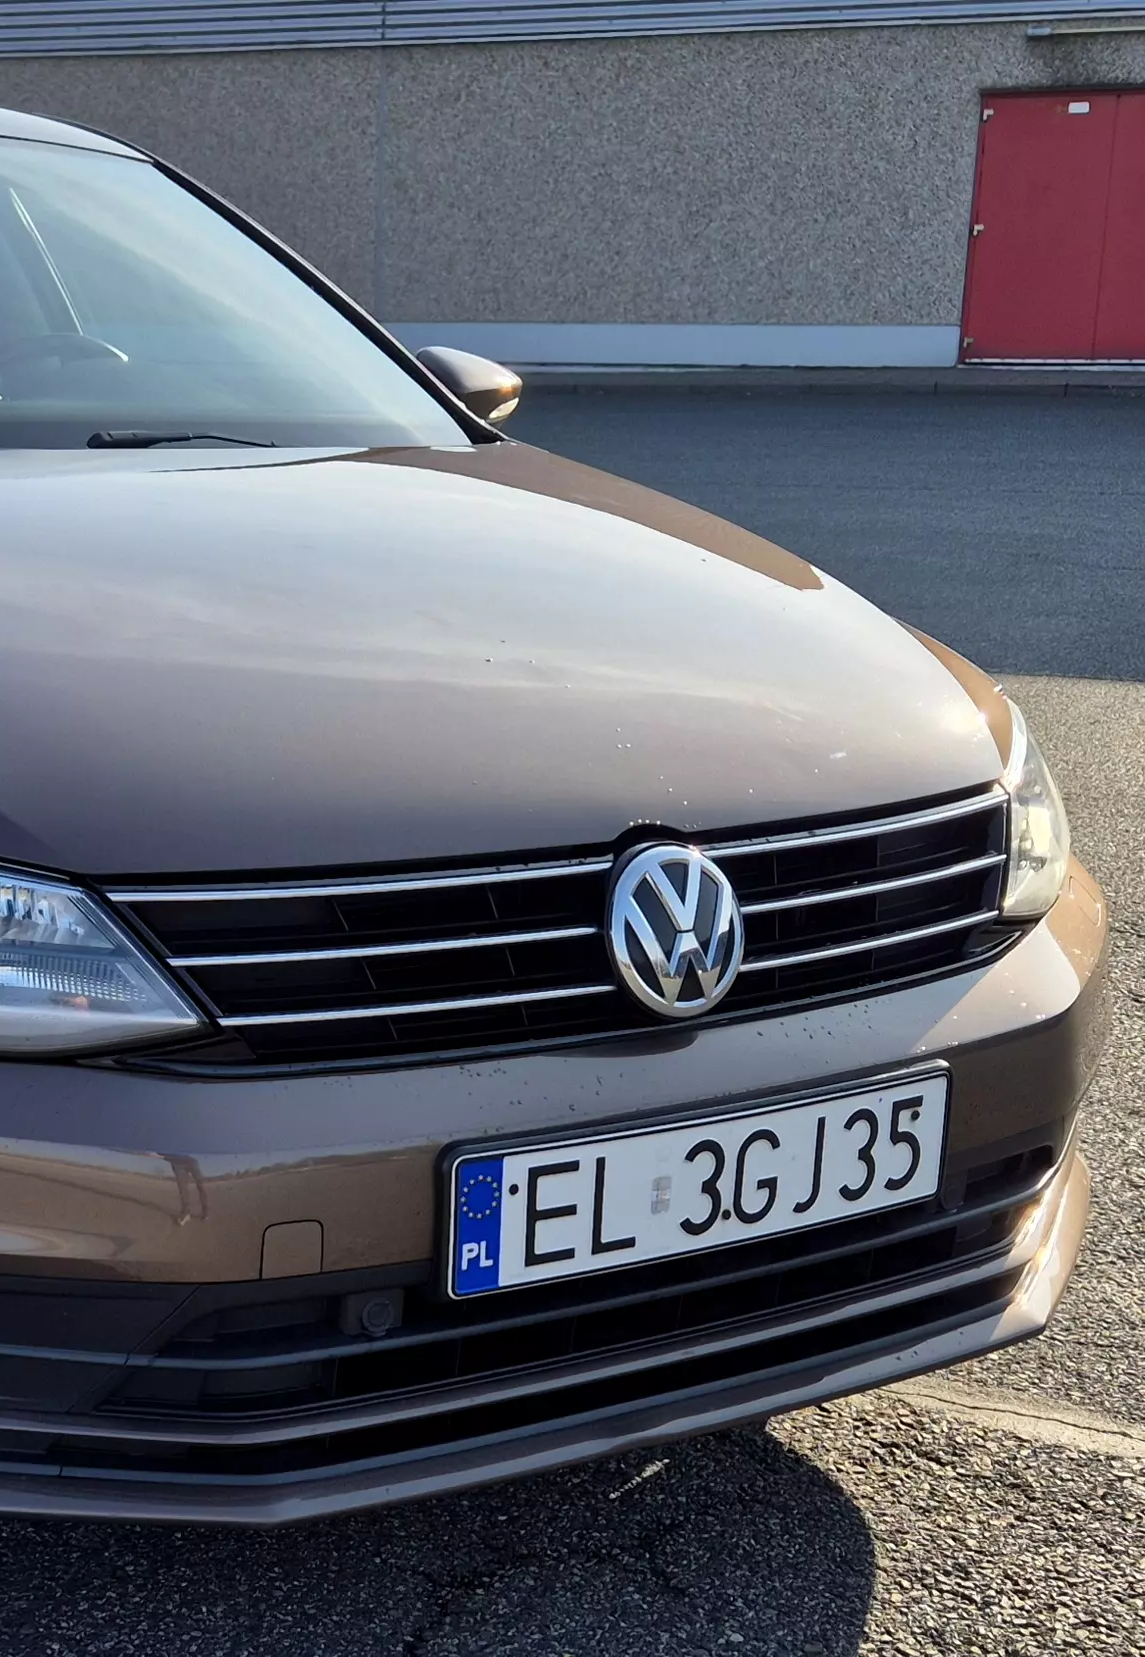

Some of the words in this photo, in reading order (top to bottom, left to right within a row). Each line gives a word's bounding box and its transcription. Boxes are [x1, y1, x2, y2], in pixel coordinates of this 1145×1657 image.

[524, 1156, 636, 1267] EL
[679, 1095, 924, 1236] 3GJ35
[461, 1241, 494, 1272] PL
